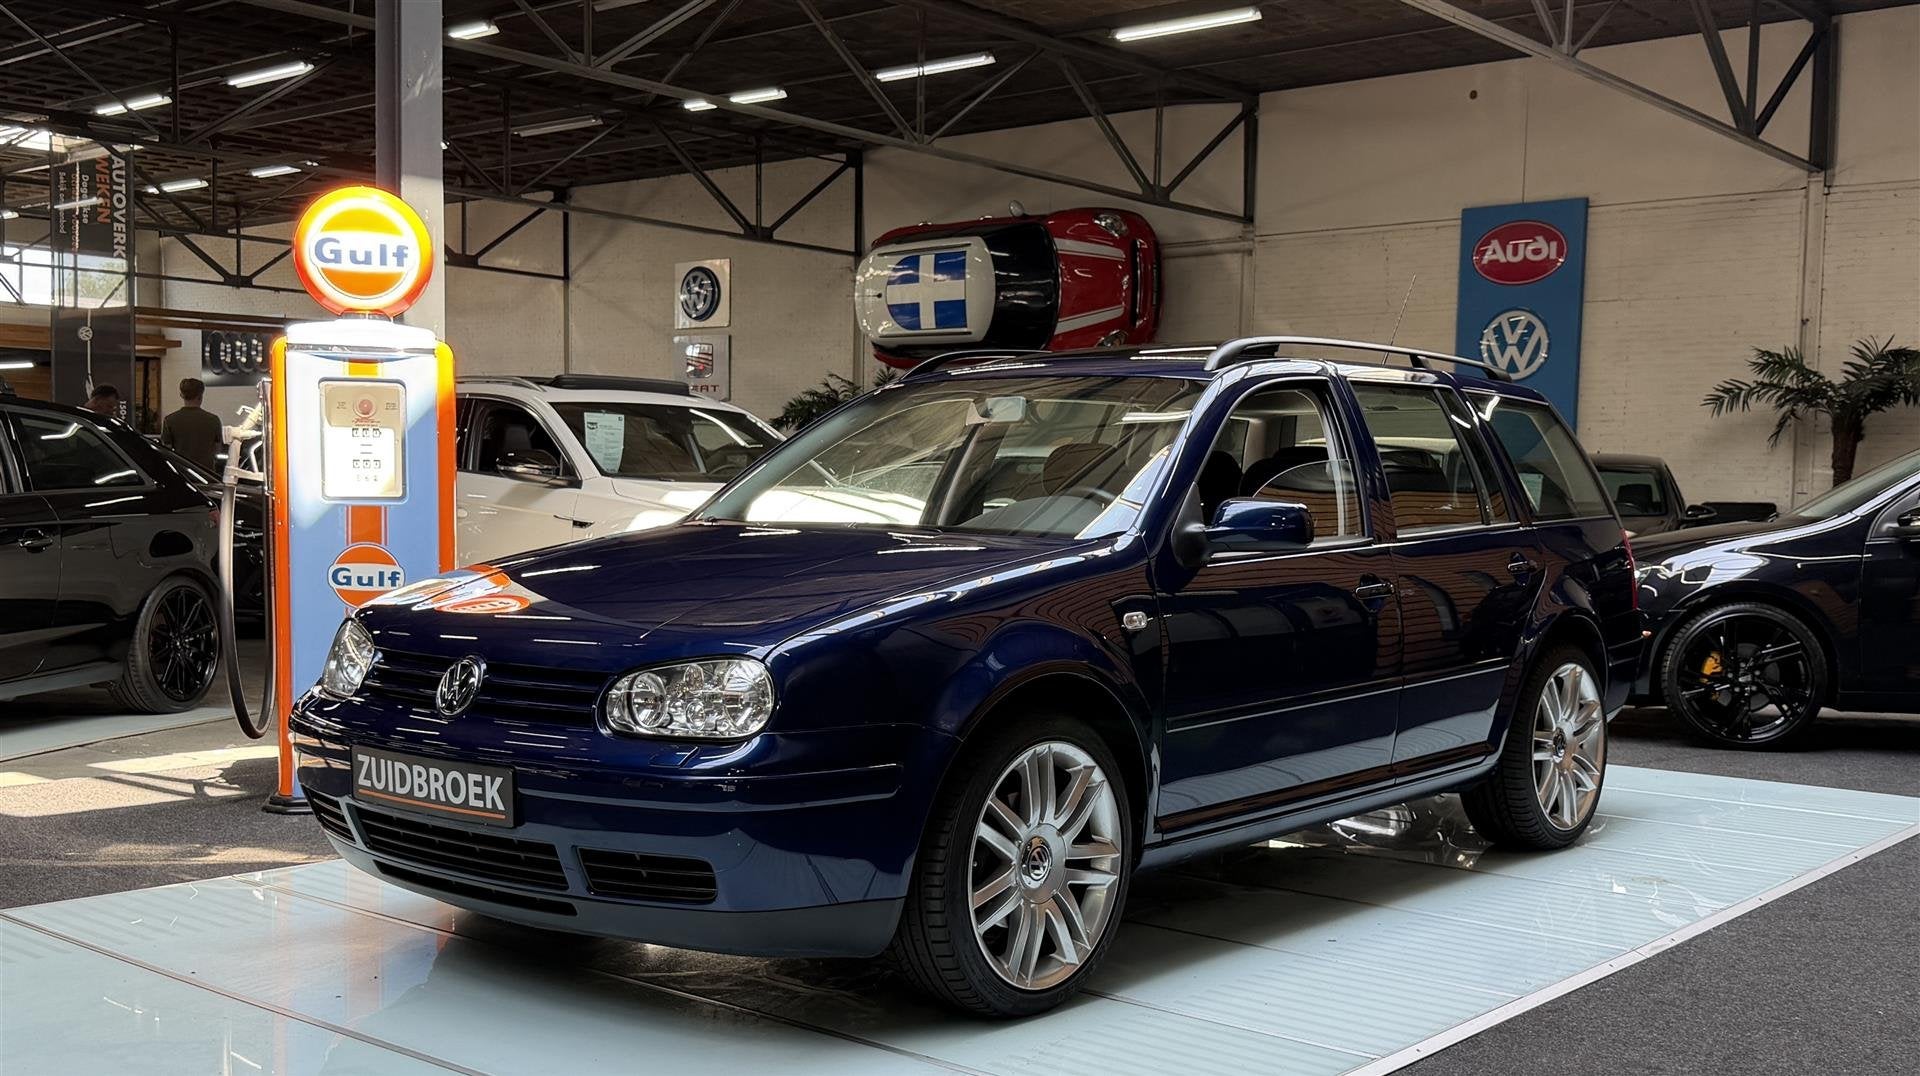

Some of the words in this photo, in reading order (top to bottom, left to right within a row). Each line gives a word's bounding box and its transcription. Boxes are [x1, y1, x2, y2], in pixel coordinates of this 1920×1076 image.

[96, 155, 111, 223] WEKEN
[314, 237, 408, 267] Gulf
[691, 384, 719, 392] EAT
[331, 567, 400, 587] Gulf
[357, 754, 505, 811] ZUIDBROEK
